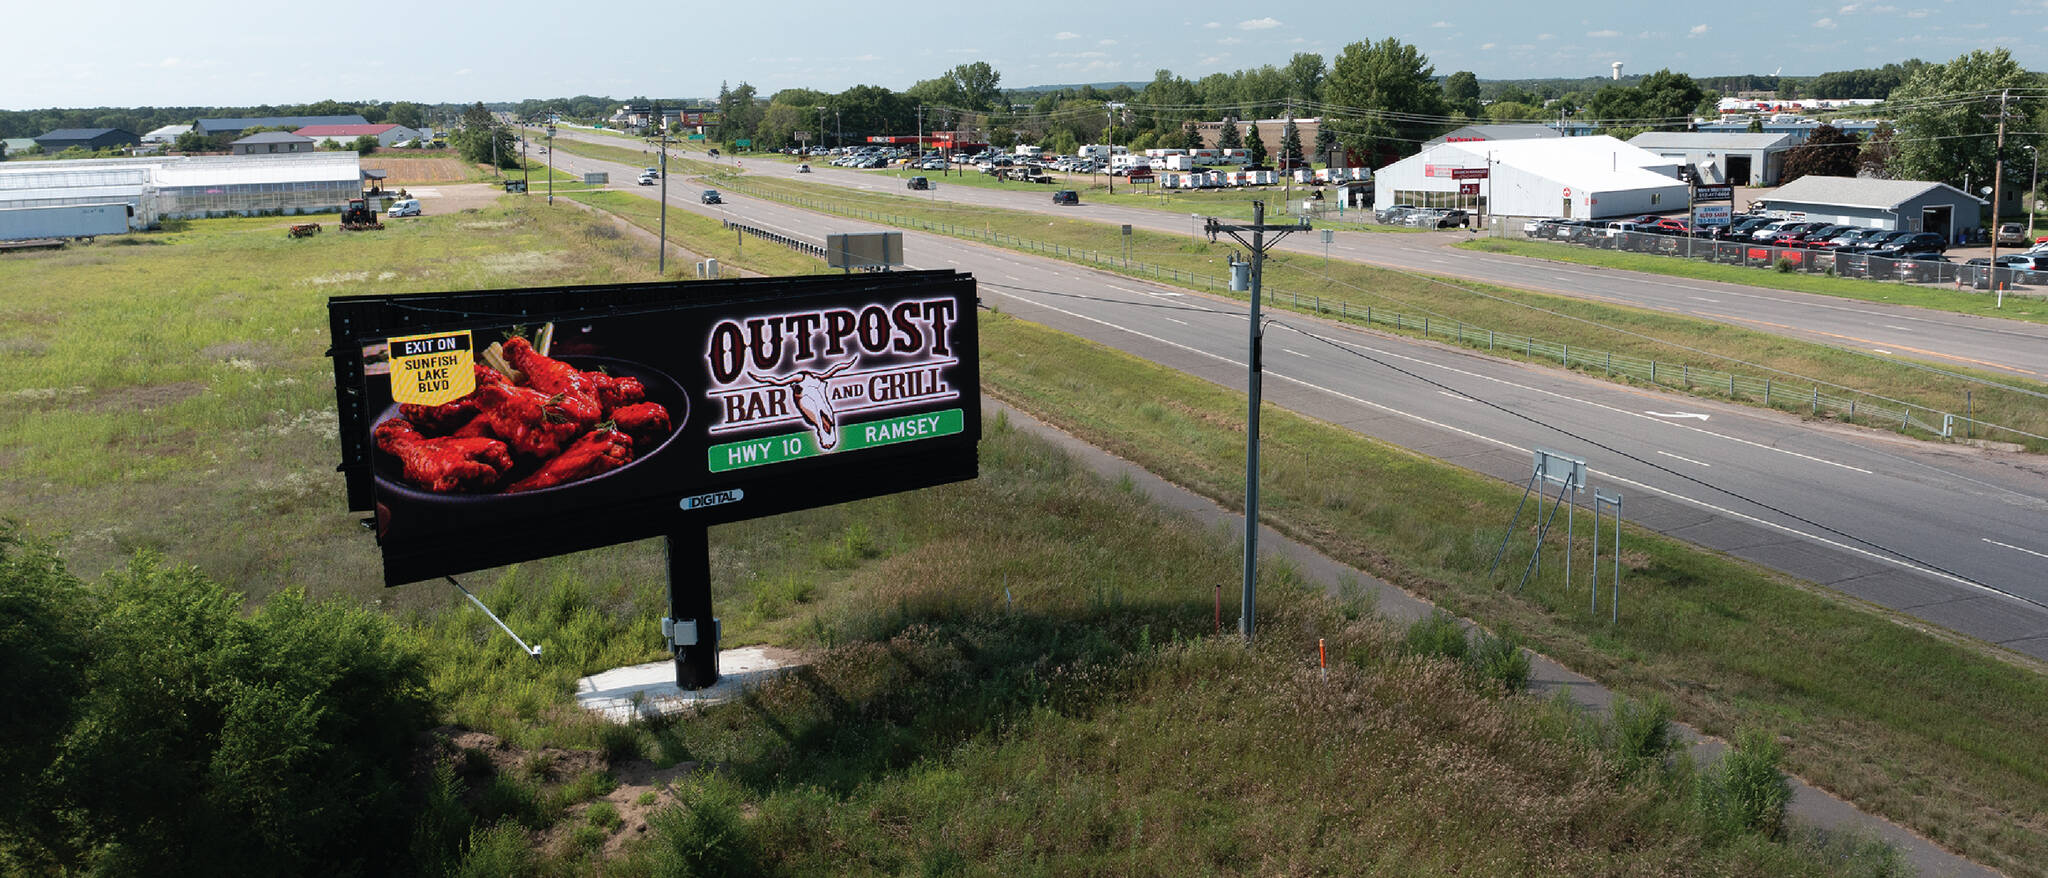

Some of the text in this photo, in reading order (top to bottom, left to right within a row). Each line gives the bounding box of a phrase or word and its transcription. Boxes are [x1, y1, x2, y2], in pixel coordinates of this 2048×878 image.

[405, 337, 456, 354] EXIT ON
[707, 298, 955, 386] OUTPOST
[405, 355, 457, 370] SUNFISH
[417, 368, 449, 381] LAKE
[418, 380, 449, 393] BLVD
[723, 368, 946, 424] BAR AND GRILL
[728, 416, 940, 465] HWY 10 RAMSEY
